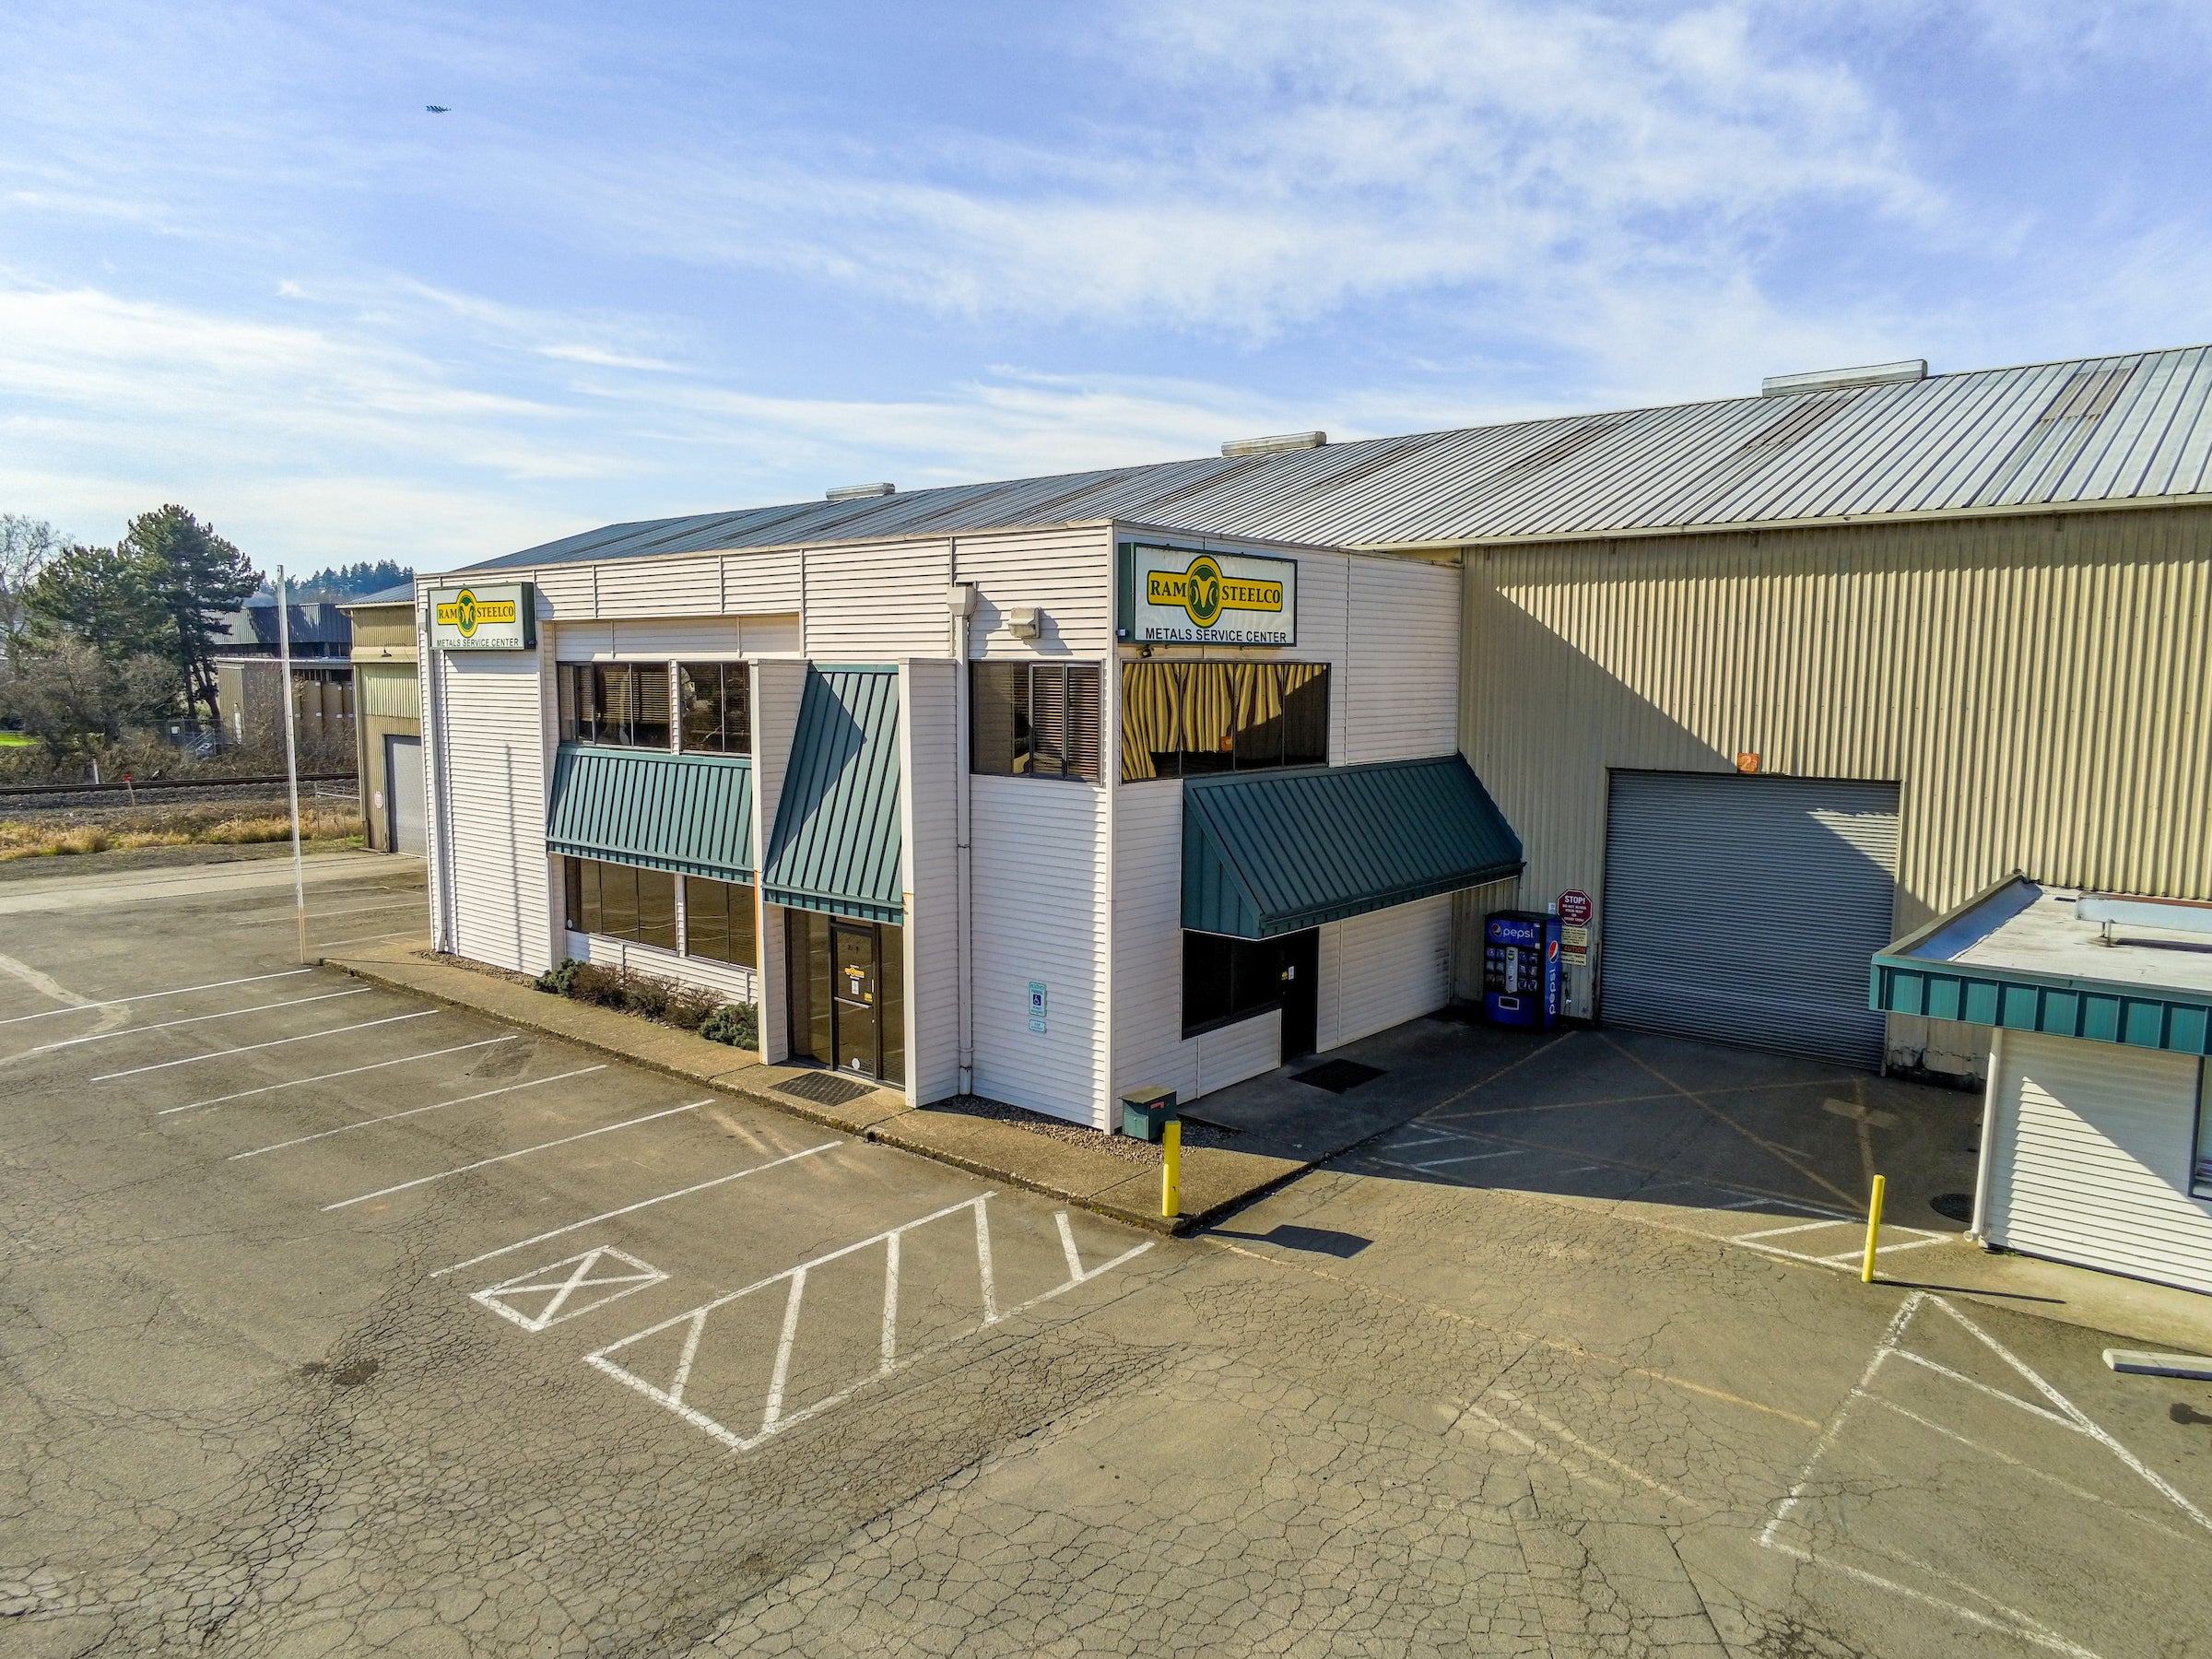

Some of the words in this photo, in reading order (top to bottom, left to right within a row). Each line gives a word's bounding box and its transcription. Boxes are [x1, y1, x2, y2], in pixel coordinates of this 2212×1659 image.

[1150, 580, 1187, 597] RAM
[1222, 585, 1280, 604] STEELCO
[439, 608, 458, 618] RAM
[477, 606, 514, 618] STEELCO
[1146, 628, 1193, 641] METALS
[1195, 629, 1242, 641] SERVICE
[1246, 630, 1287, 643] CENTER
[437, 639, 461, 647] METALS
[463, 638, 489, 647] SERVICE
[491, 638, 519, 647] CENTER
[1564, 895, 1585, 905] STOP!
[1502, 927, 1534, 939] pepsi
